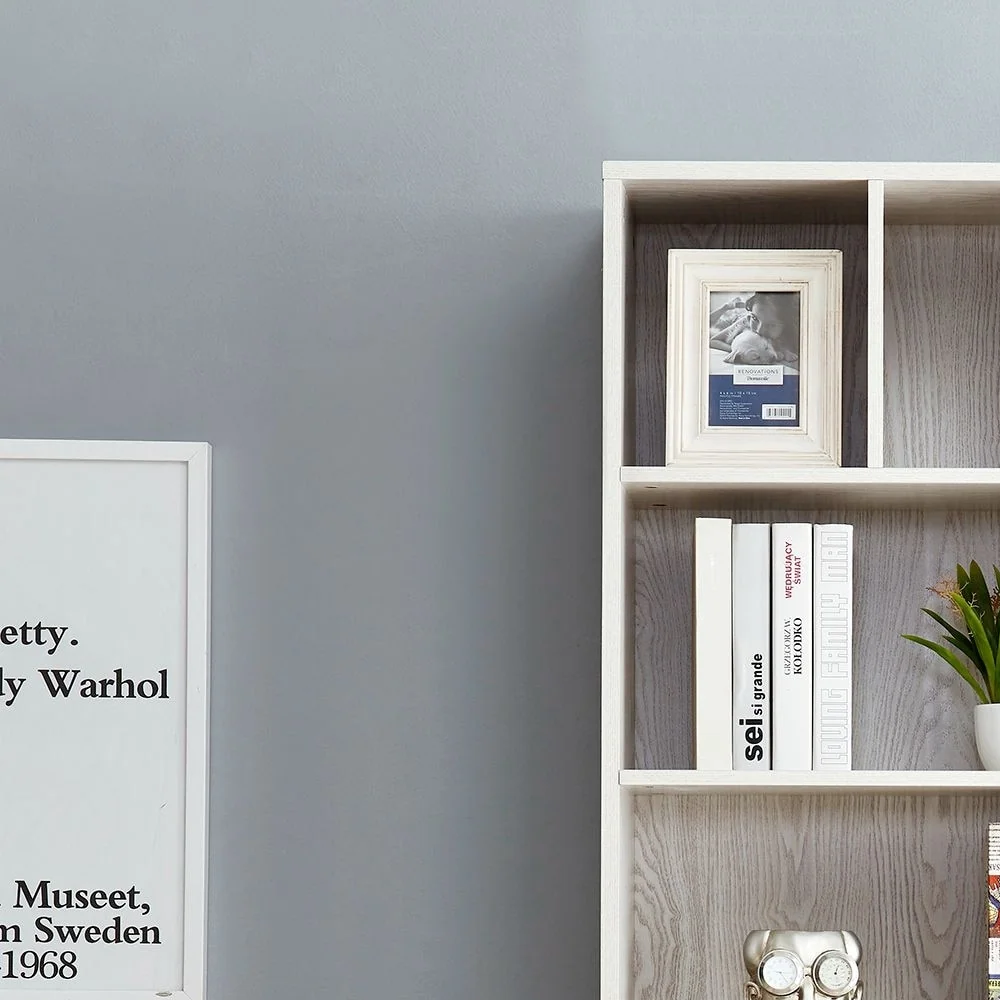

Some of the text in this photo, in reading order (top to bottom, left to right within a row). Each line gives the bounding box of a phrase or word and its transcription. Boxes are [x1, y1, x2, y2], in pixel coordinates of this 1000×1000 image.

[38, 669, 169, 700] Warhol
[739, 654, 765, 762] sei si grande
[13, 880, 151, 916] Museet,
[35, 916, 162, 945] Sweden
